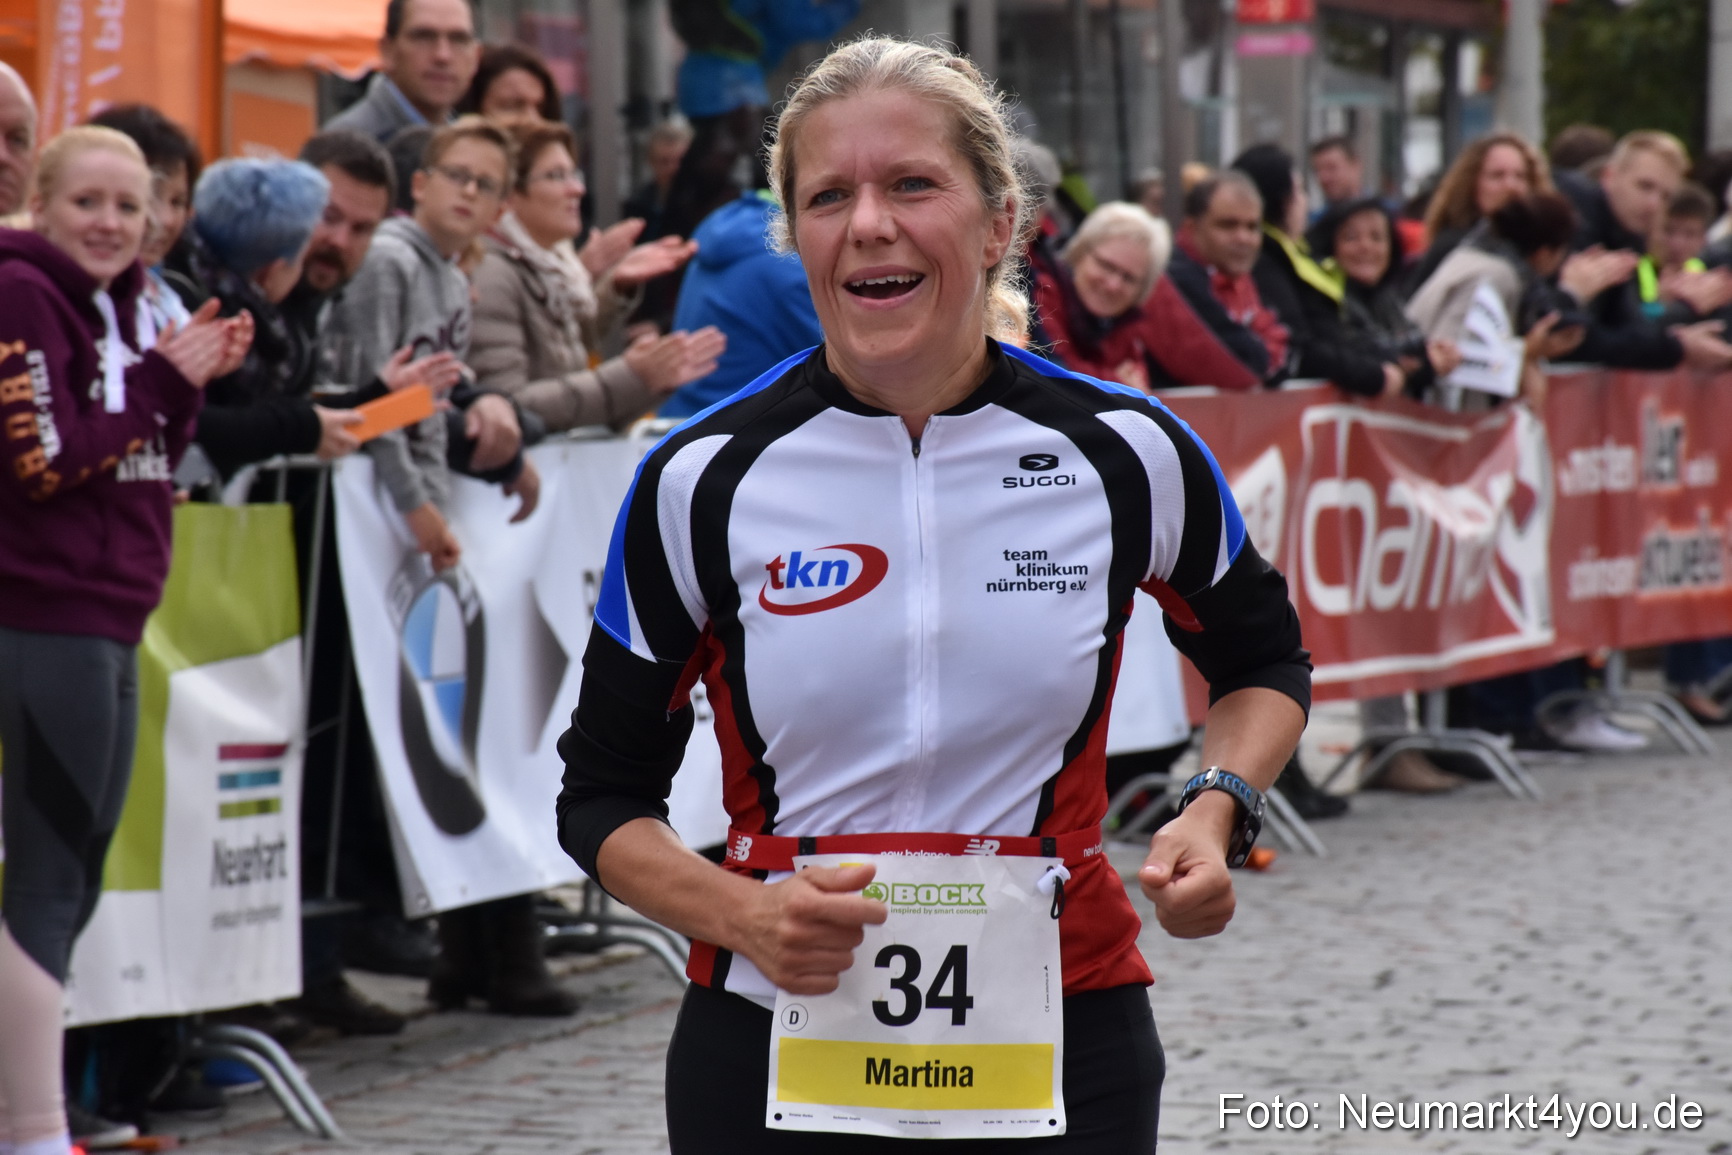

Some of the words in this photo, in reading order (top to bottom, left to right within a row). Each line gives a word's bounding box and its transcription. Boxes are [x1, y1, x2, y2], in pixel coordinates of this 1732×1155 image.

[1003, 549, 1048, 561] team
[765, 551, 849, 590] tkn
[1016, 563, 1088, 576] klinikum
[986, 578, 1066, 594] nürnberg
[1083, 847, 1094, 858] new
[891, 883, 987, 906] BOCK
[890, 907, 921, 915] inspired
[923, 907, 932, 915] by
[872, 944, 974, 1027] 34
[789, 1010, 799, 1025] D
[865, 1057, 974, 1088] Martina
